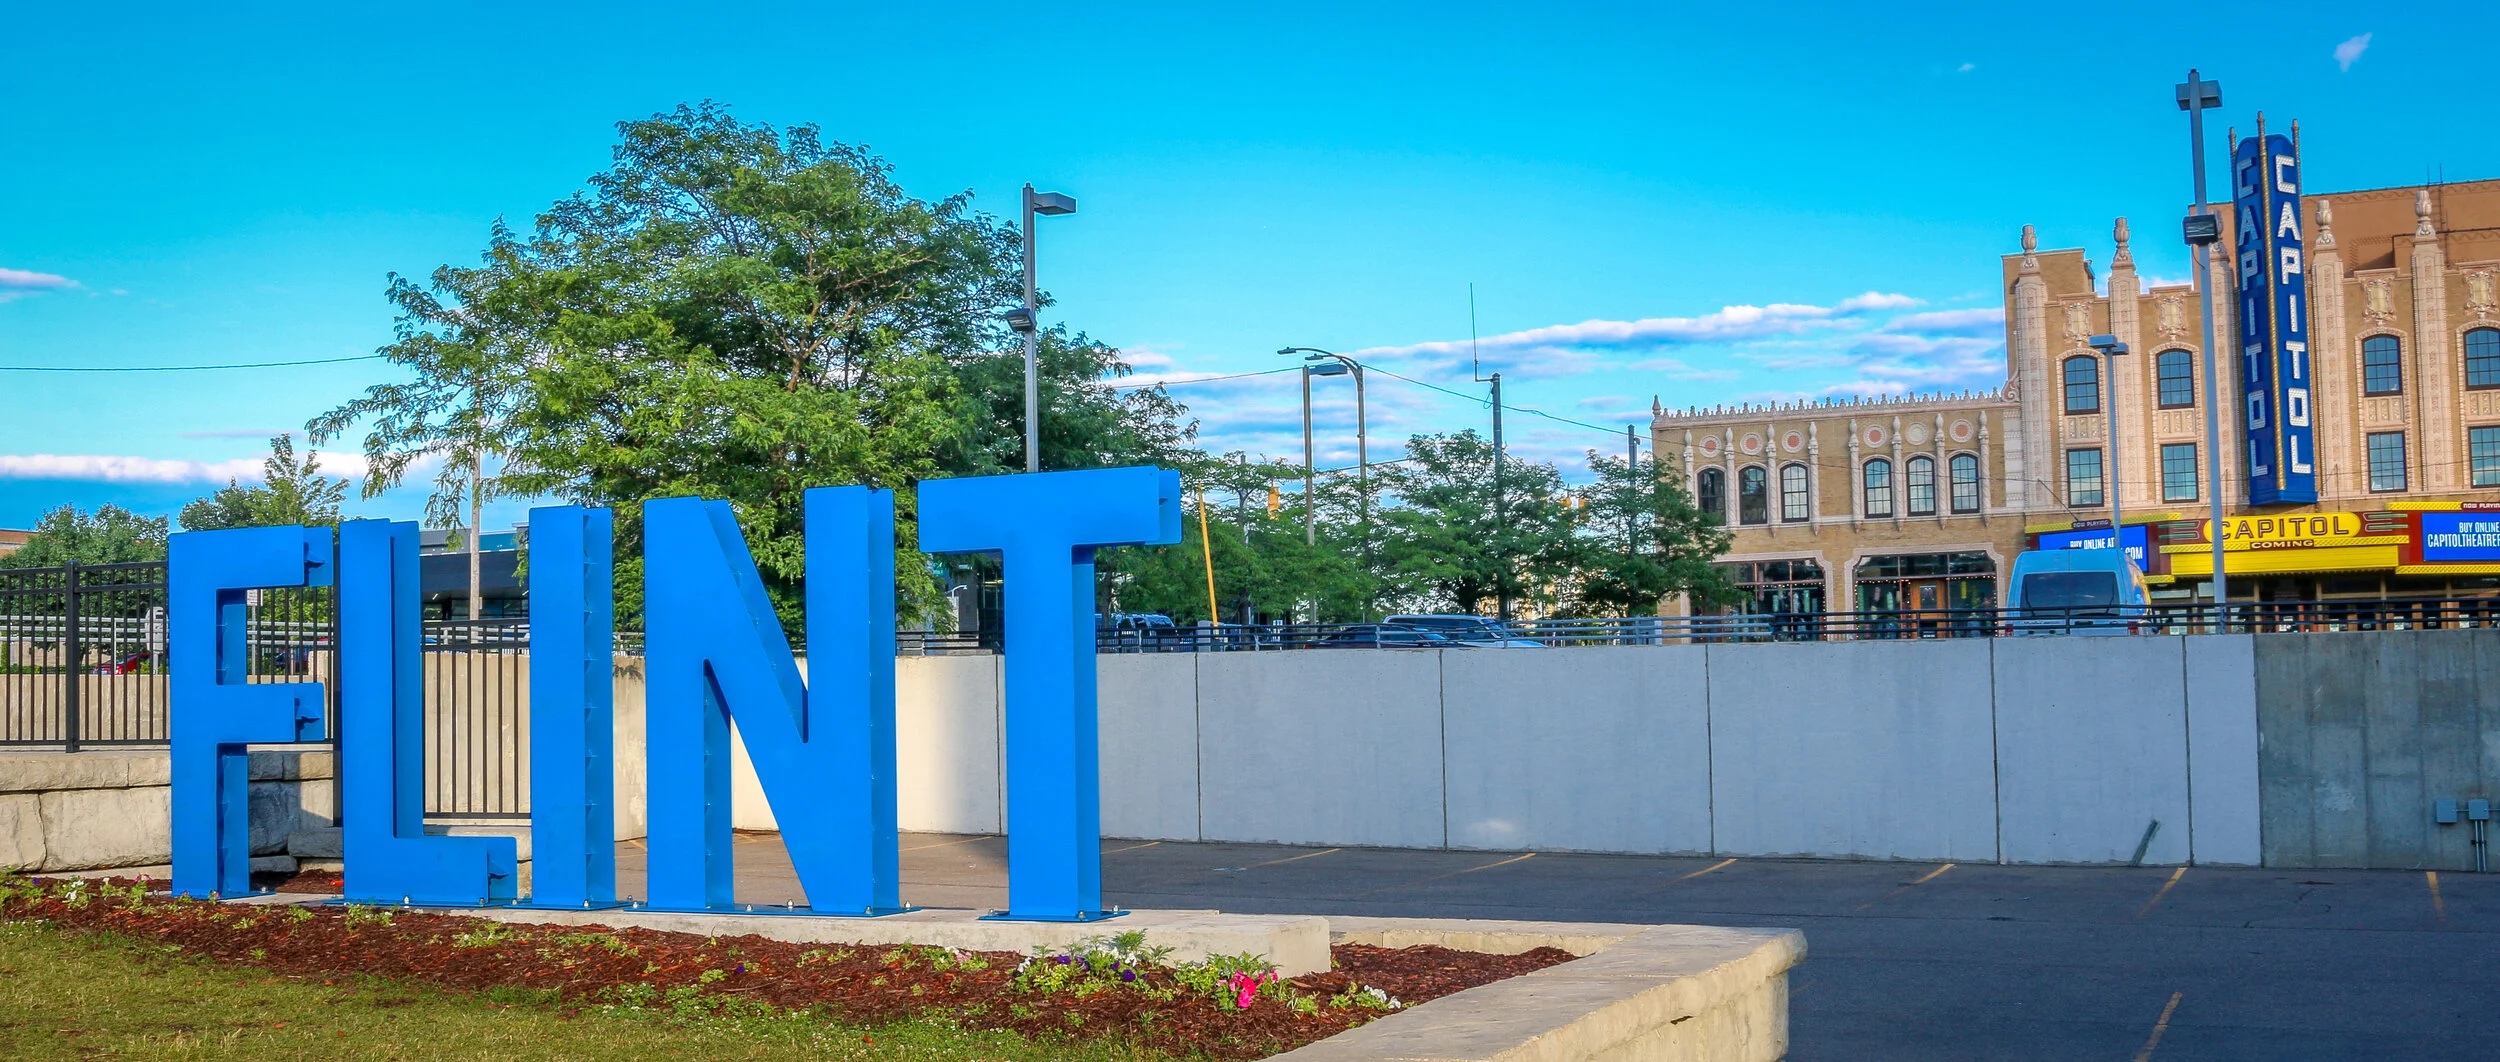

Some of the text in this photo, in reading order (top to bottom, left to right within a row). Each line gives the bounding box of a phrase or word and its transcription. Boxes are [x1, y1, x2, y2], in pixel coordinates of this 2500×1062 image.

[2237, 156, 2268, 477] CAPITOL
[2275, 154, 2312, 474] CAPITOL
[2221, 516, 2349, 540] CAPITOL
[2458, 521, 2500, 533] BUY ONLINE
[2083, 537, 2106, 550] ONLINE
[2107, 537, 2115, 548] AT
[2251, 539, 2314, 549] COMING
[168, 465, 1183, 921] FLINT
